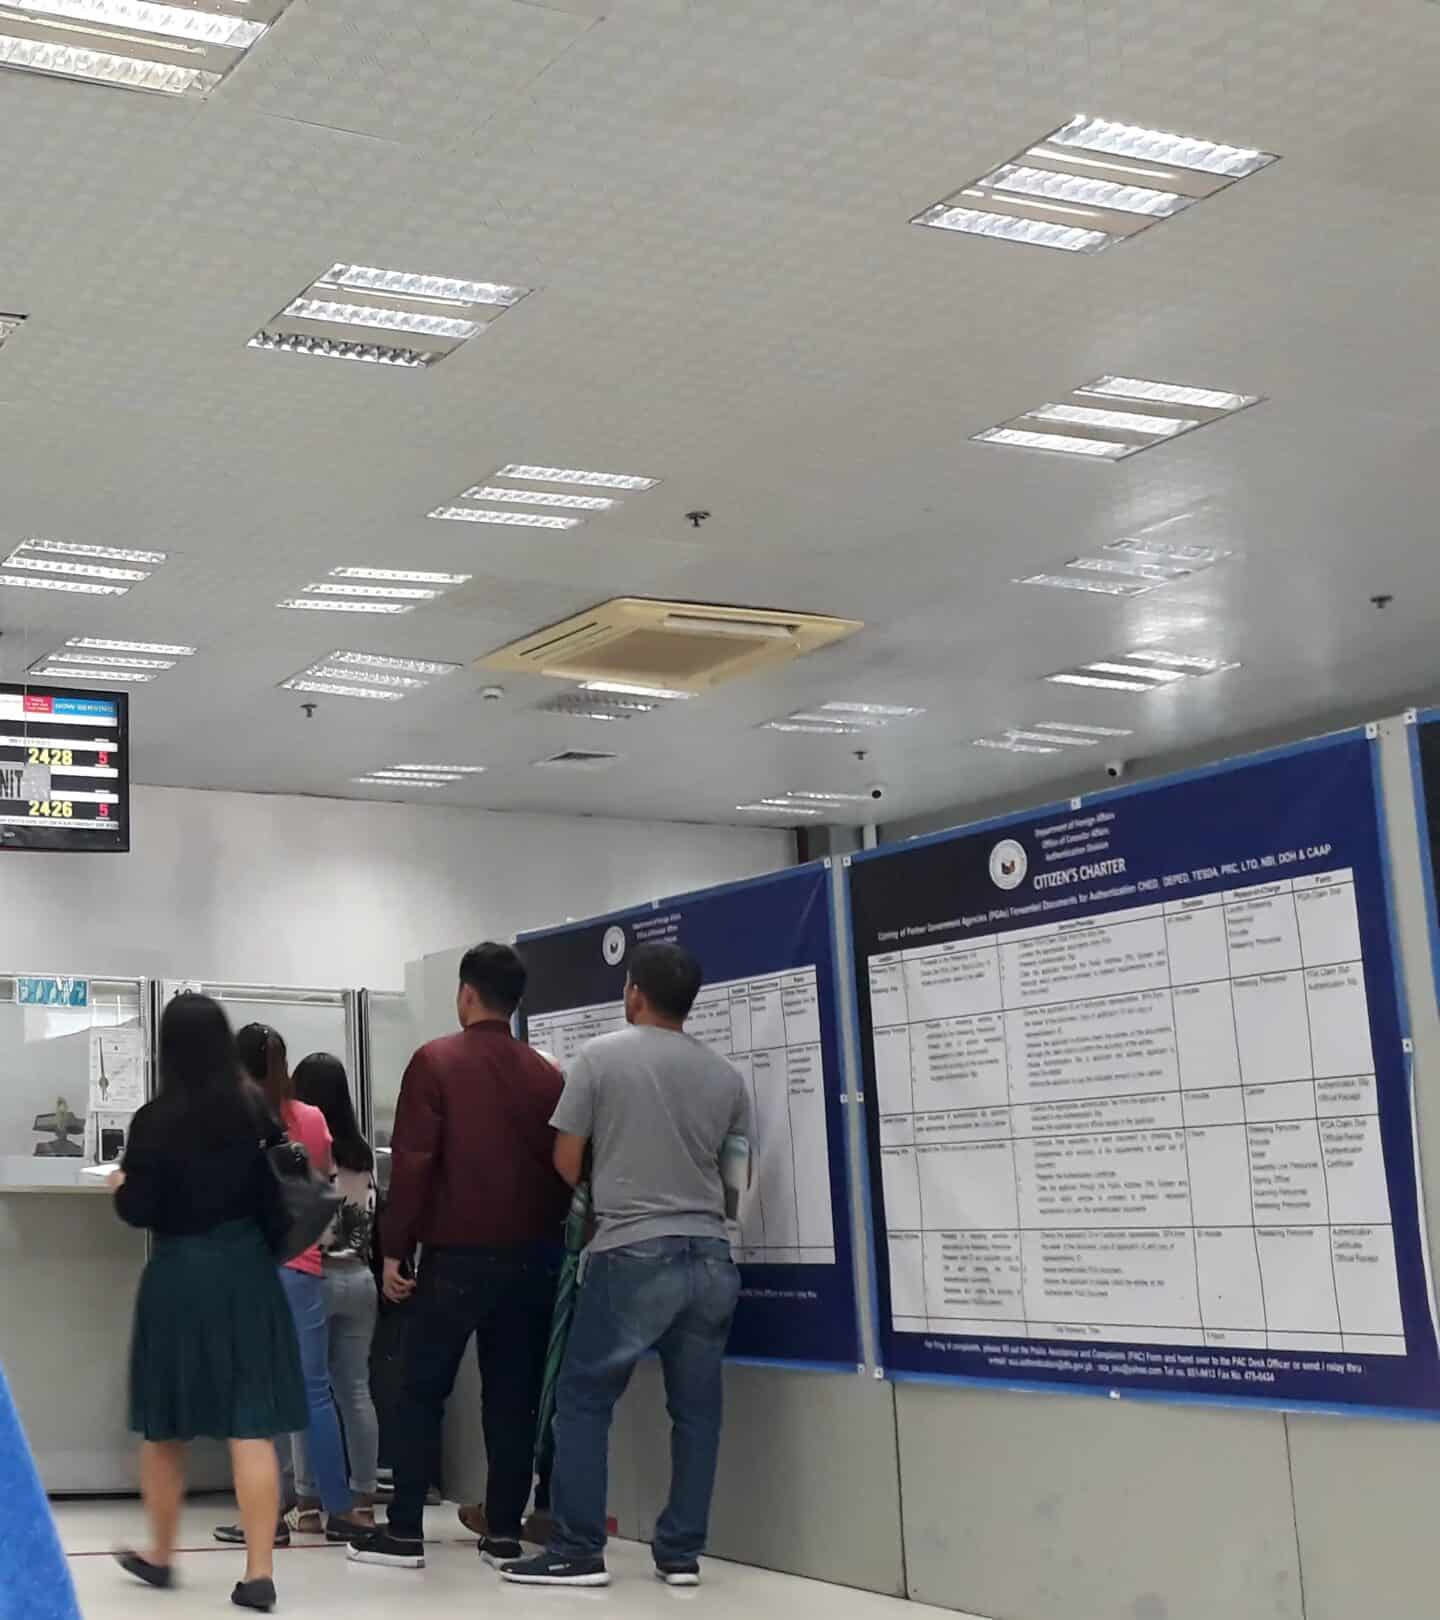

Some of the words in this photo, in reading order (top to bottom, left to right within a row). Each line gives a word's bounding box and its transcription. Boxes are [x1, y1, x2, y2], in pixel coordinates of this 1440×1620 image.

[29, 748, 73, 766] 2428
[98, 751, 108, 765] 5
[29, 800, 73, 817] 2426
[98, 803, 109, 817] 5
[1306, 842, 1332, 858] CAAP
[1033, 866, 1078, 890] CITIZEN'S
[1079, 857, 1126, 881] CHARTER
